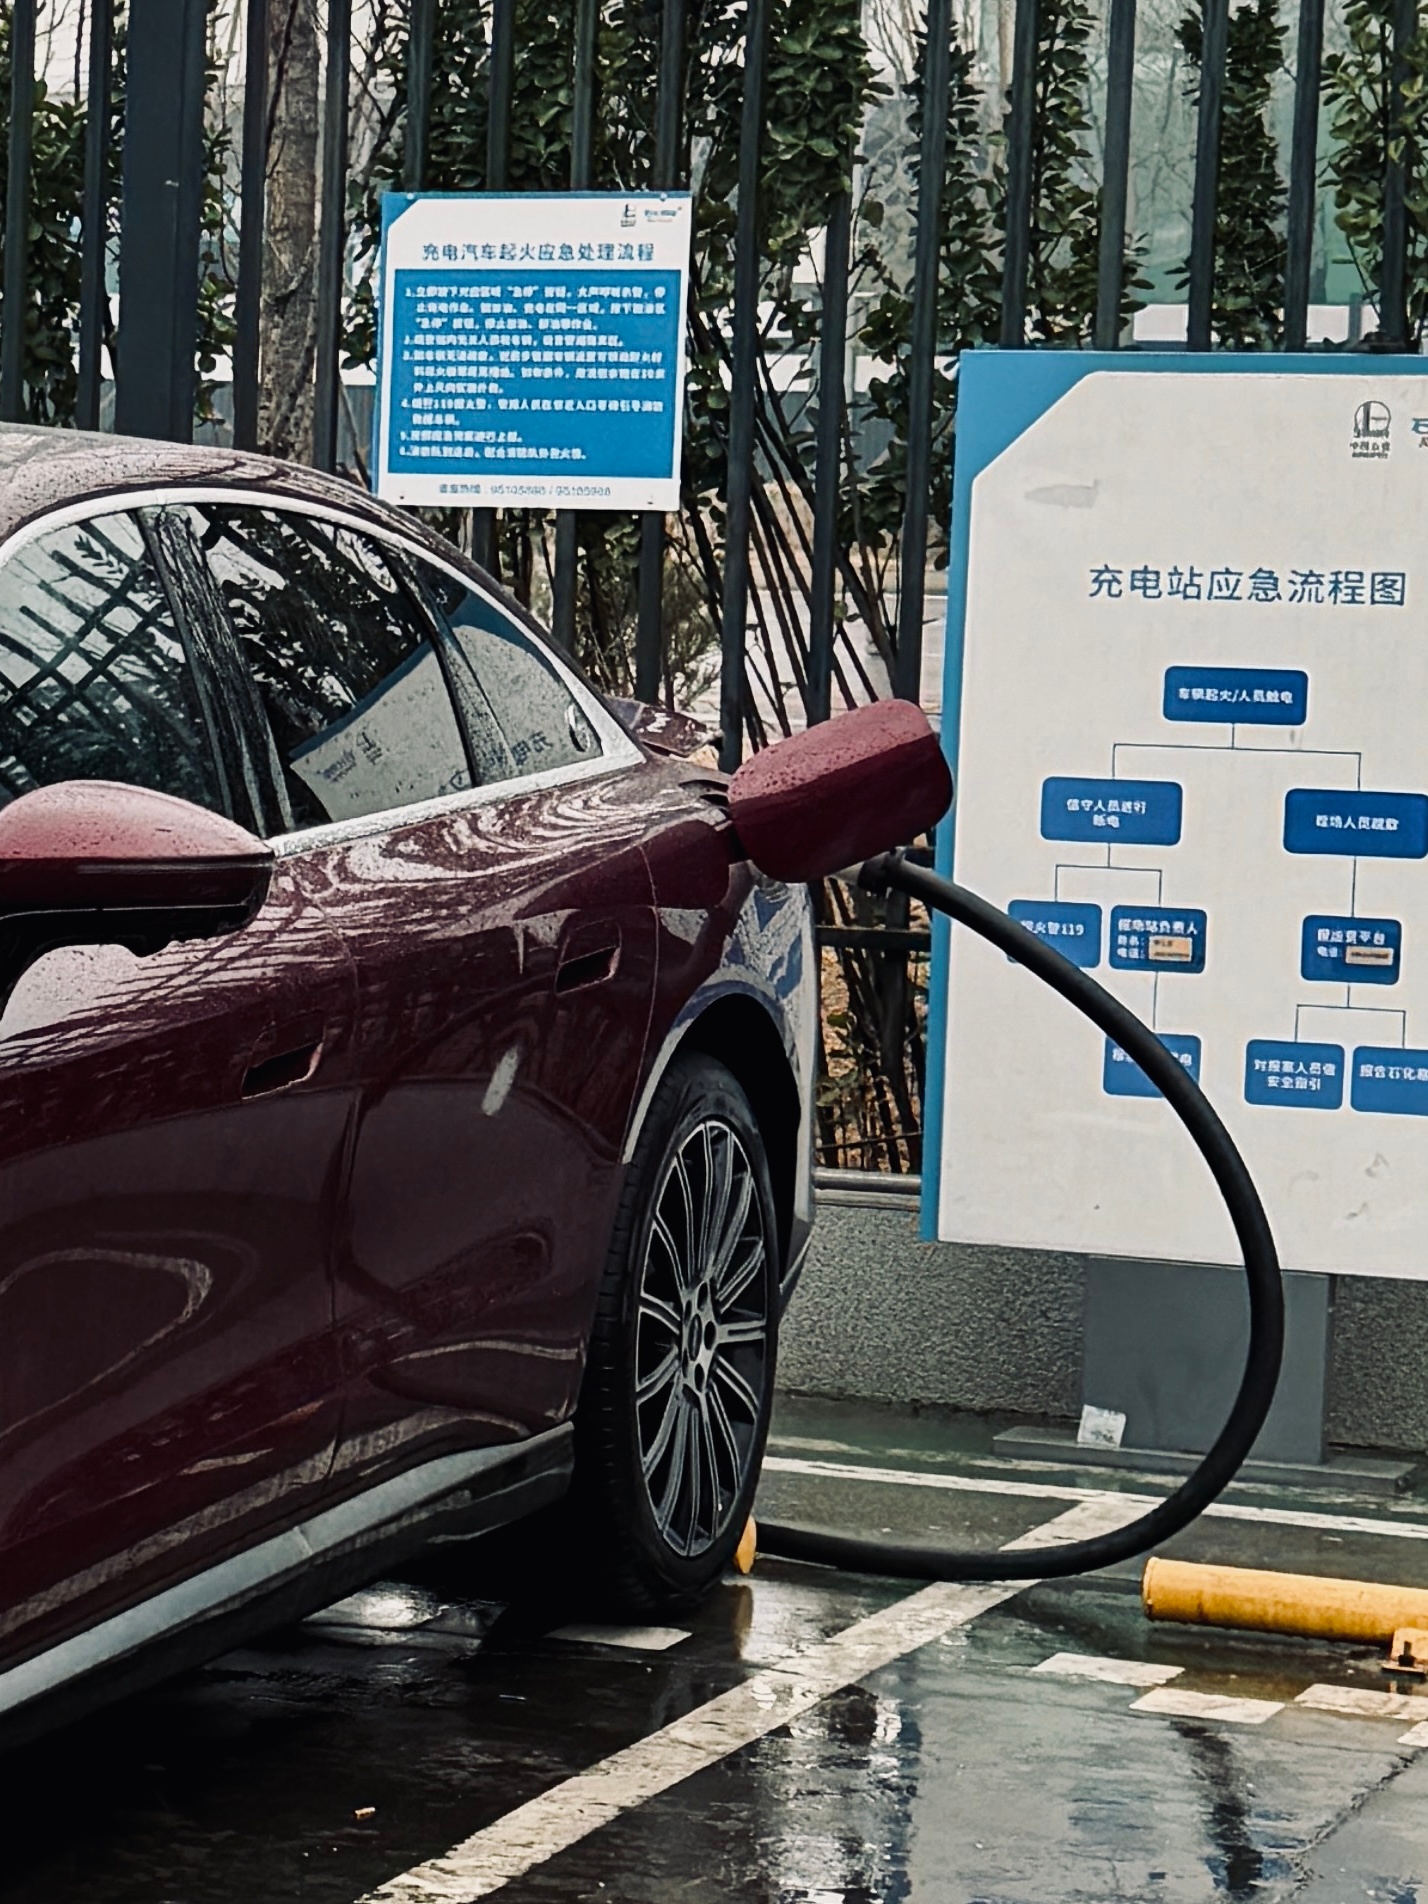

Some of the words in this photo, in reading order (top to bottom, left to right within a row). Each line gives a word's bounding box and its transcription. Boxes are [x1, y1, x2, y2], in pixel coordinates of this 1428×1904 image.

[422, 243, 655, 262] 充电汽车起火应急处理流程
[1088, 564, 1407, 607] 充电站应急流程图
